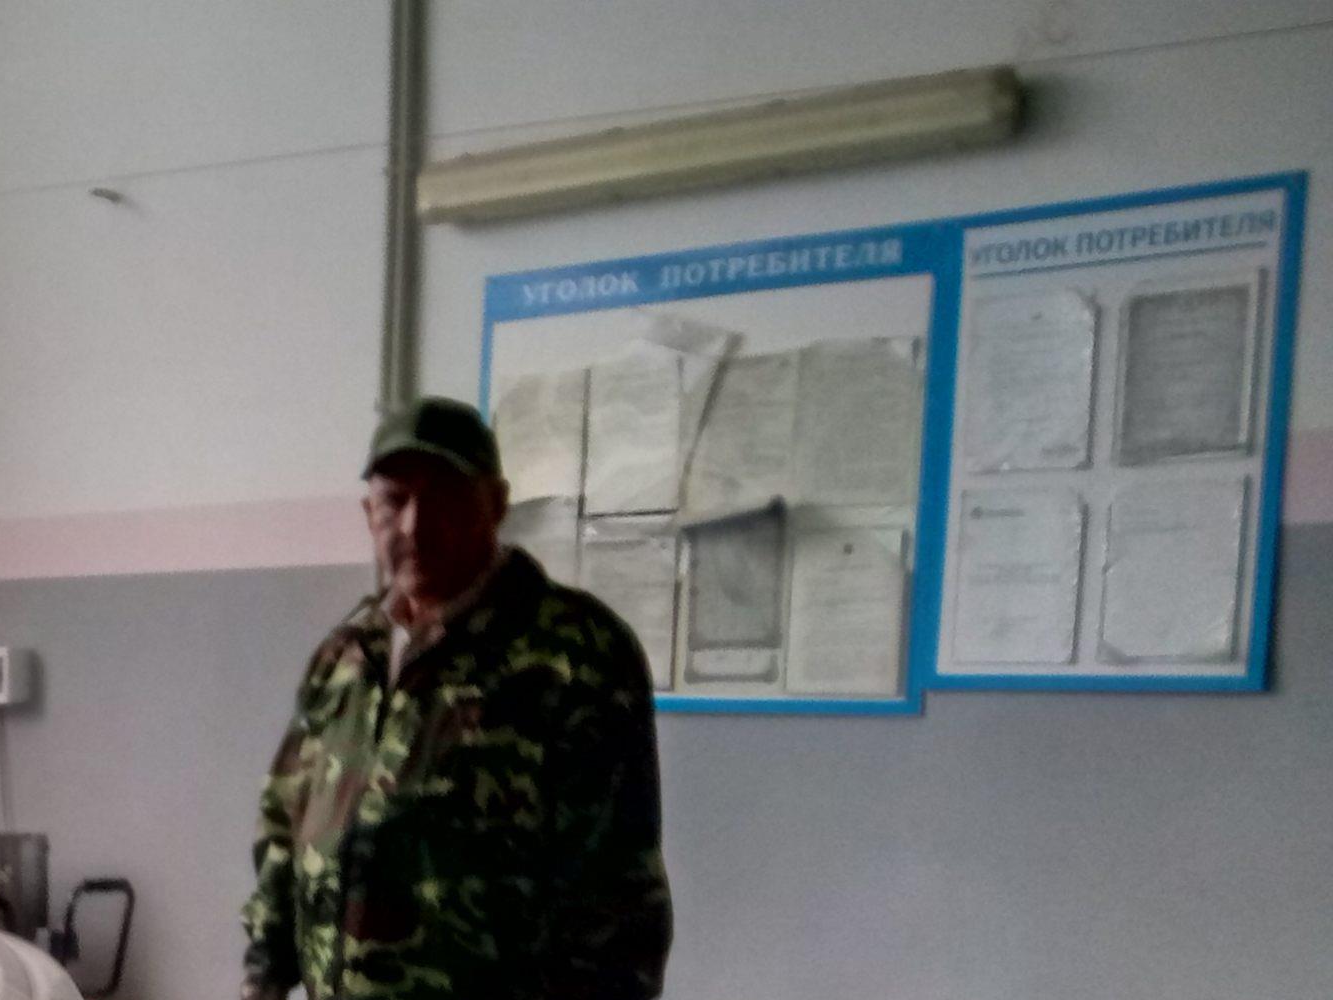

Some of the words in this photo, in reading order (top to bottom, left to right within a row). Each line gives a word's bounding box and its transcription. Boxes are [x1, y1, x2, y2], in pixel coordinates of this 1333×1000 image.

[970, 235, 1067, 266] УГОЛОК
[1075, 209, 1276, 257] ПОТРЕБИТЕЛЯ
[521, 270, 639, 307] УГОЛОК
[659, 237, 904, 289] ПОТРЕБИТЕЛЯ
